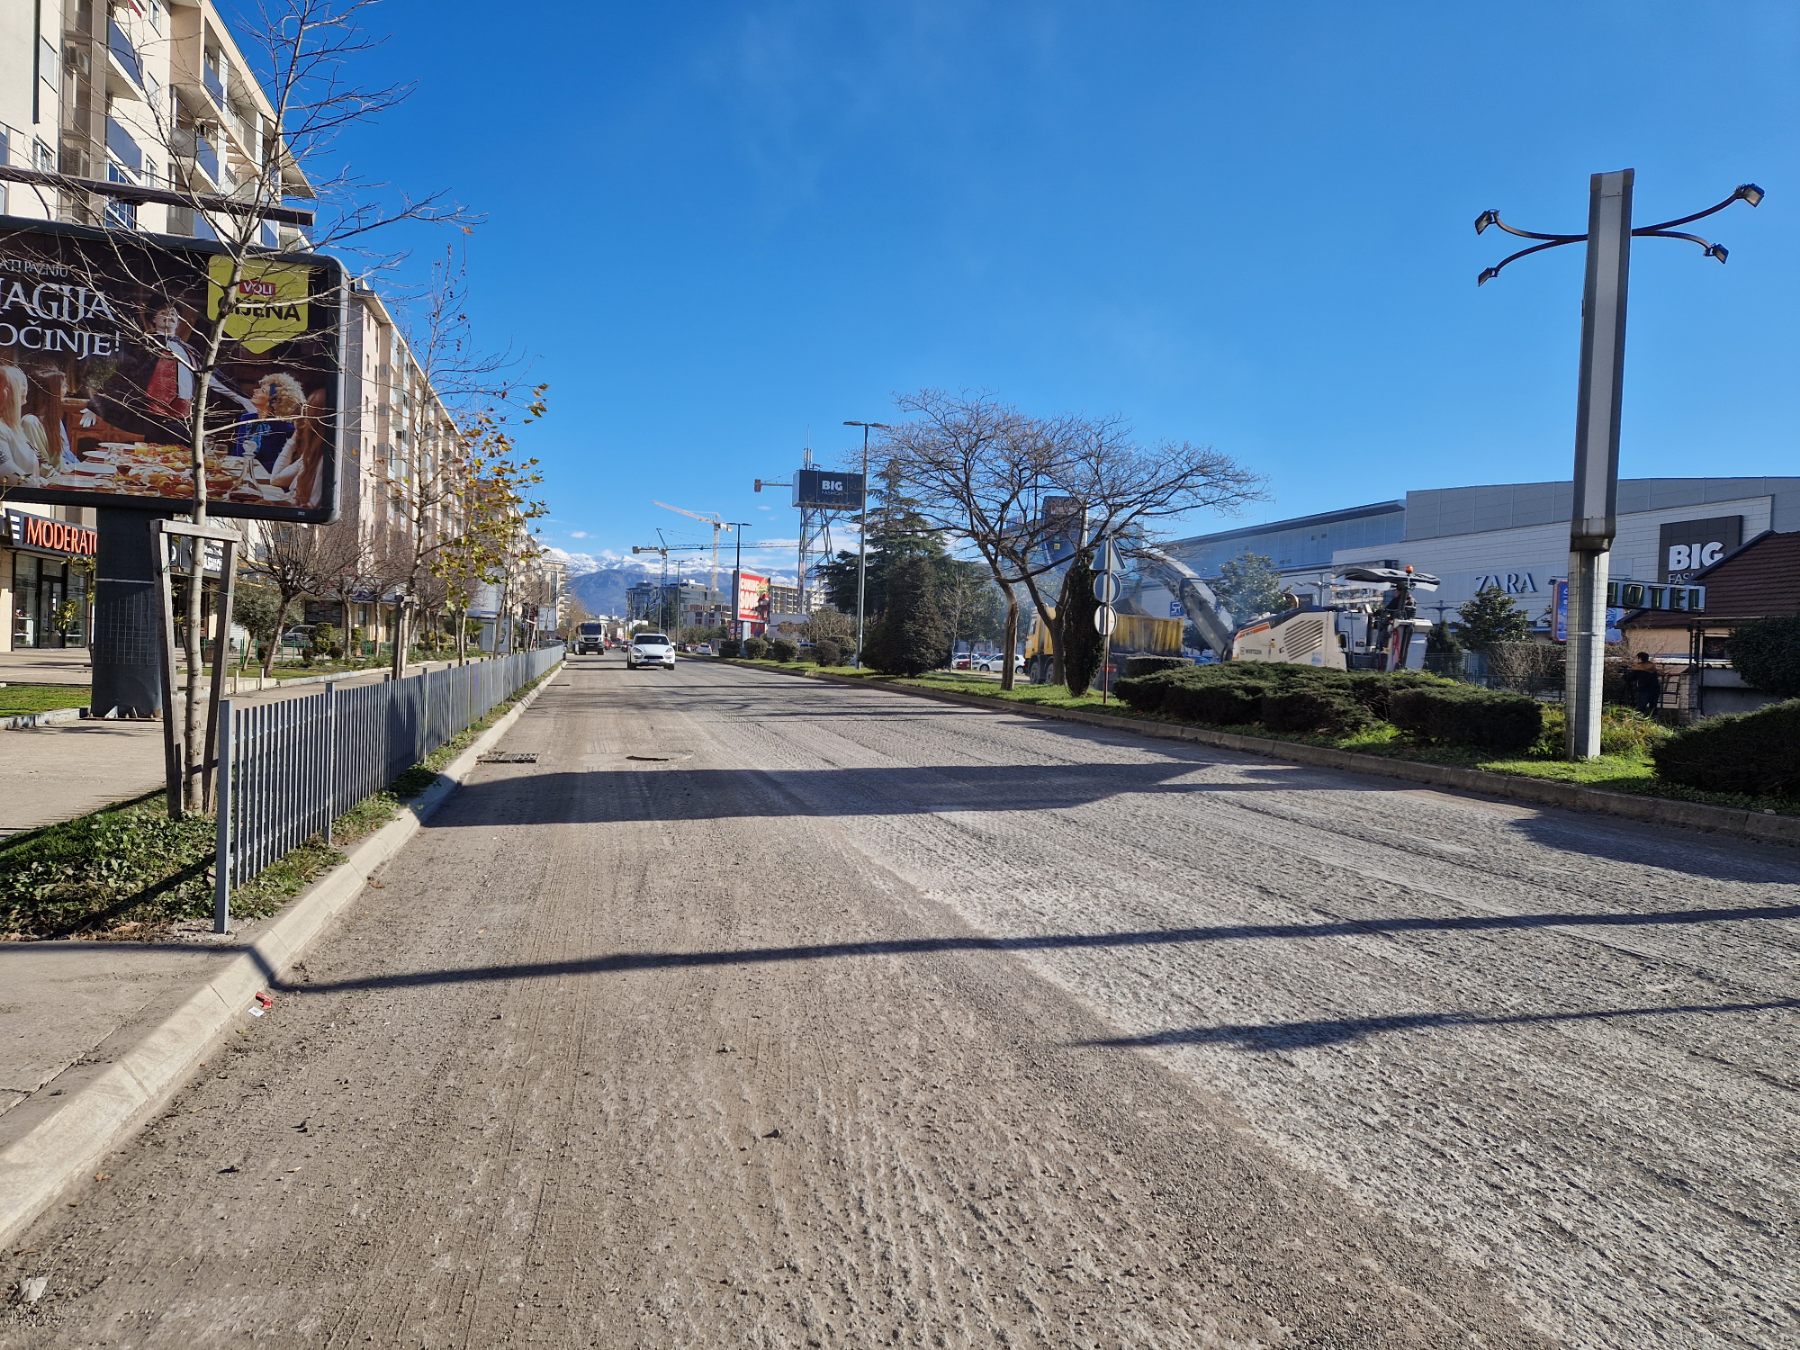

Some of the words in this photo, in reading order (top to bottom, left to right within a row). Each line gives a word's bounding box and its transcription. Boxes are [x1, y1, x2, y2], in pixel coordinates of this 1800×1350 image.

[0, 278, 116, 324] AGIJA
[243, 281, 273, 296] VOLI
[218, 296, 301, 322] IJENA
[0, 319, 121, 360] OČINJE!
[822, 480, 843, 491] BIG
[26, 517, 98, 555] MODERAT
[1668, 541, 1724, 571] BIG
[1475, 572, 1538, 594] ZARA
[1668, 572, 1695, 585] FAS
